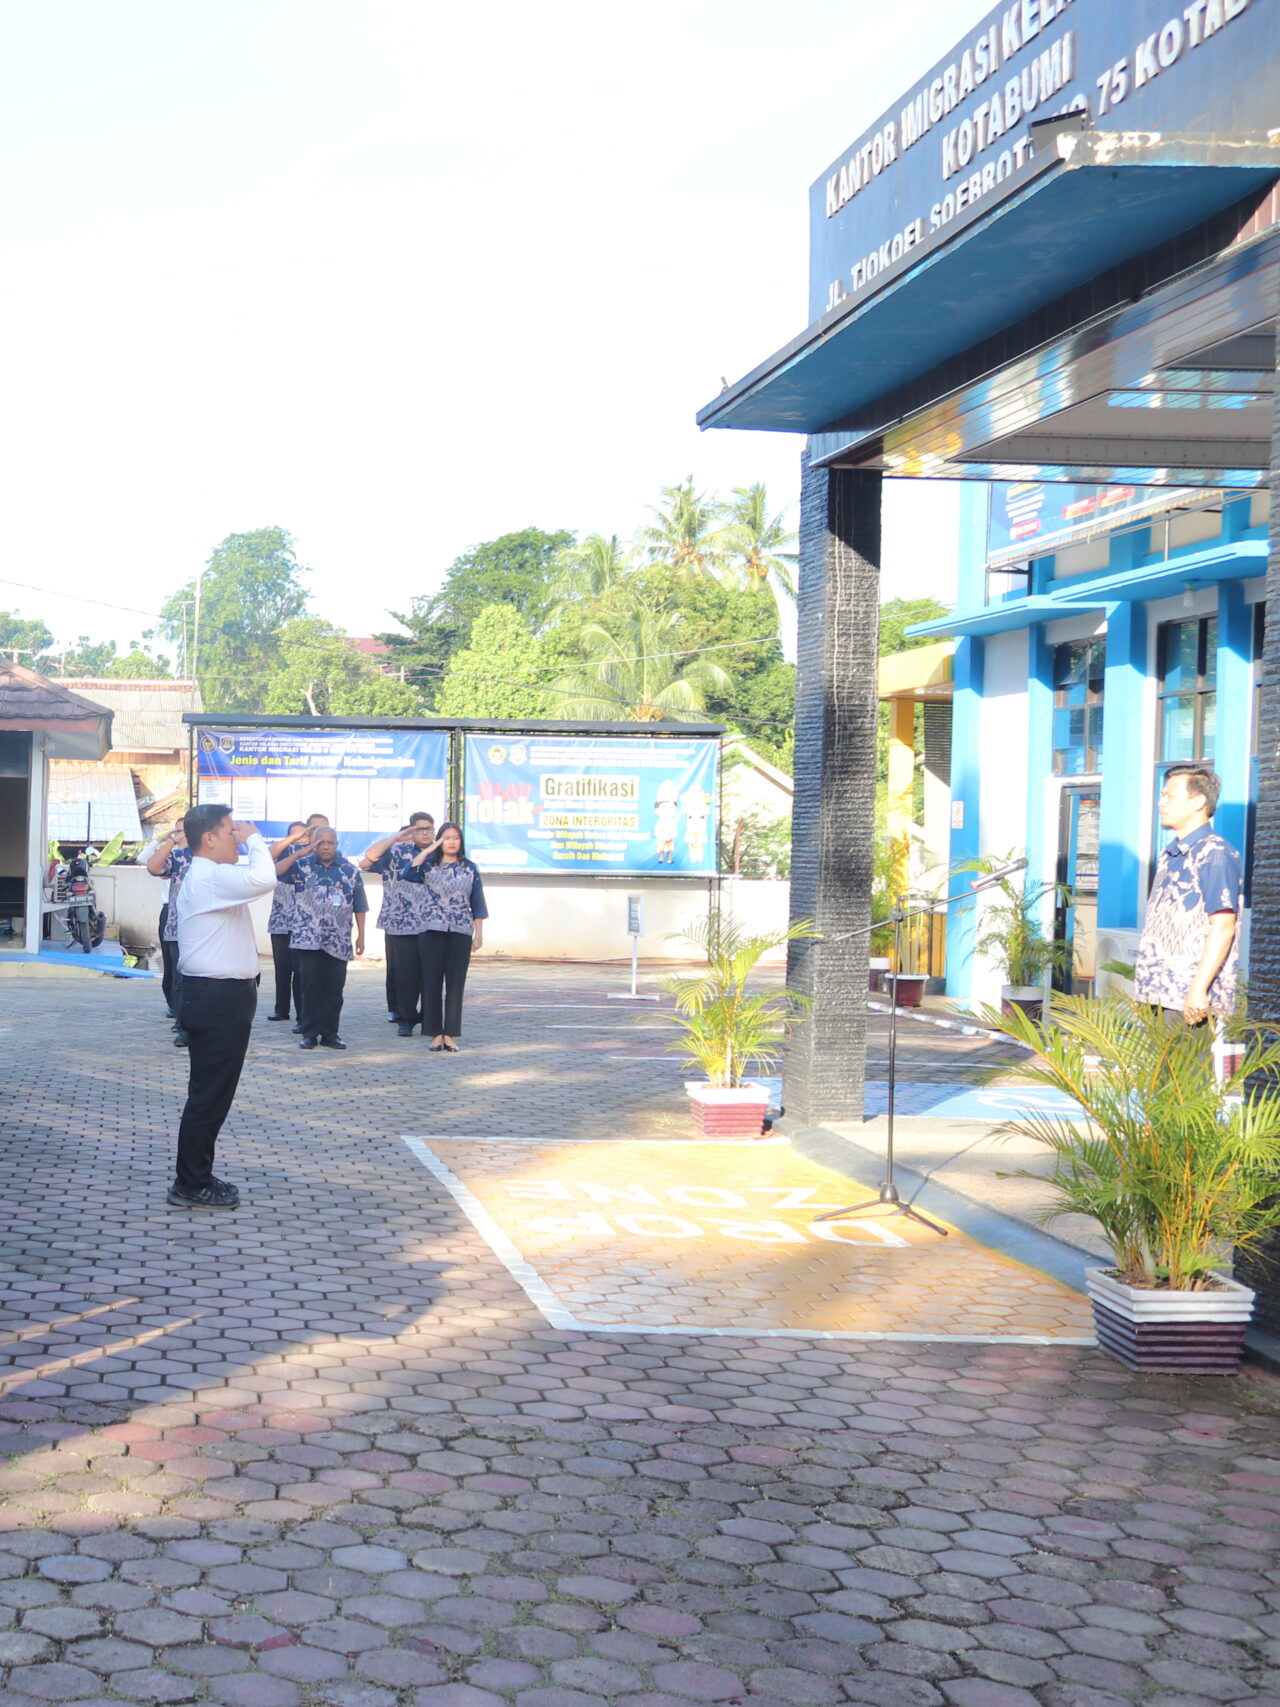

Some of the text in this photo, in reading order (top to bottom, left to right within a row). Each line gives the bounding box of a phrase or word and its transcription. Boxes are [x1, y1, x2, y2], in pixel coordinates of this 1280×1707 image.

[826, 0, 1073, 218] KANTOR IMIGRASI KEL
[942, 29, 1075, 180] KOTABUMI
[826, 278, 848, 311] JL.
[1096, 57, 1129, 116] 75
[230, 755, 259, 765] Jenis
[261, 755, 281, 765] dan
[283, 755, 309, 766] Tarif
[545, 777, 635, 798] Gratifikasi
[465, 793, 535, 825] Tolak
[543, 815, 569, 826] ZONA
[503, 1179, 846, 1211] ZONE
[527, 1211, 913, 1249] DROP
